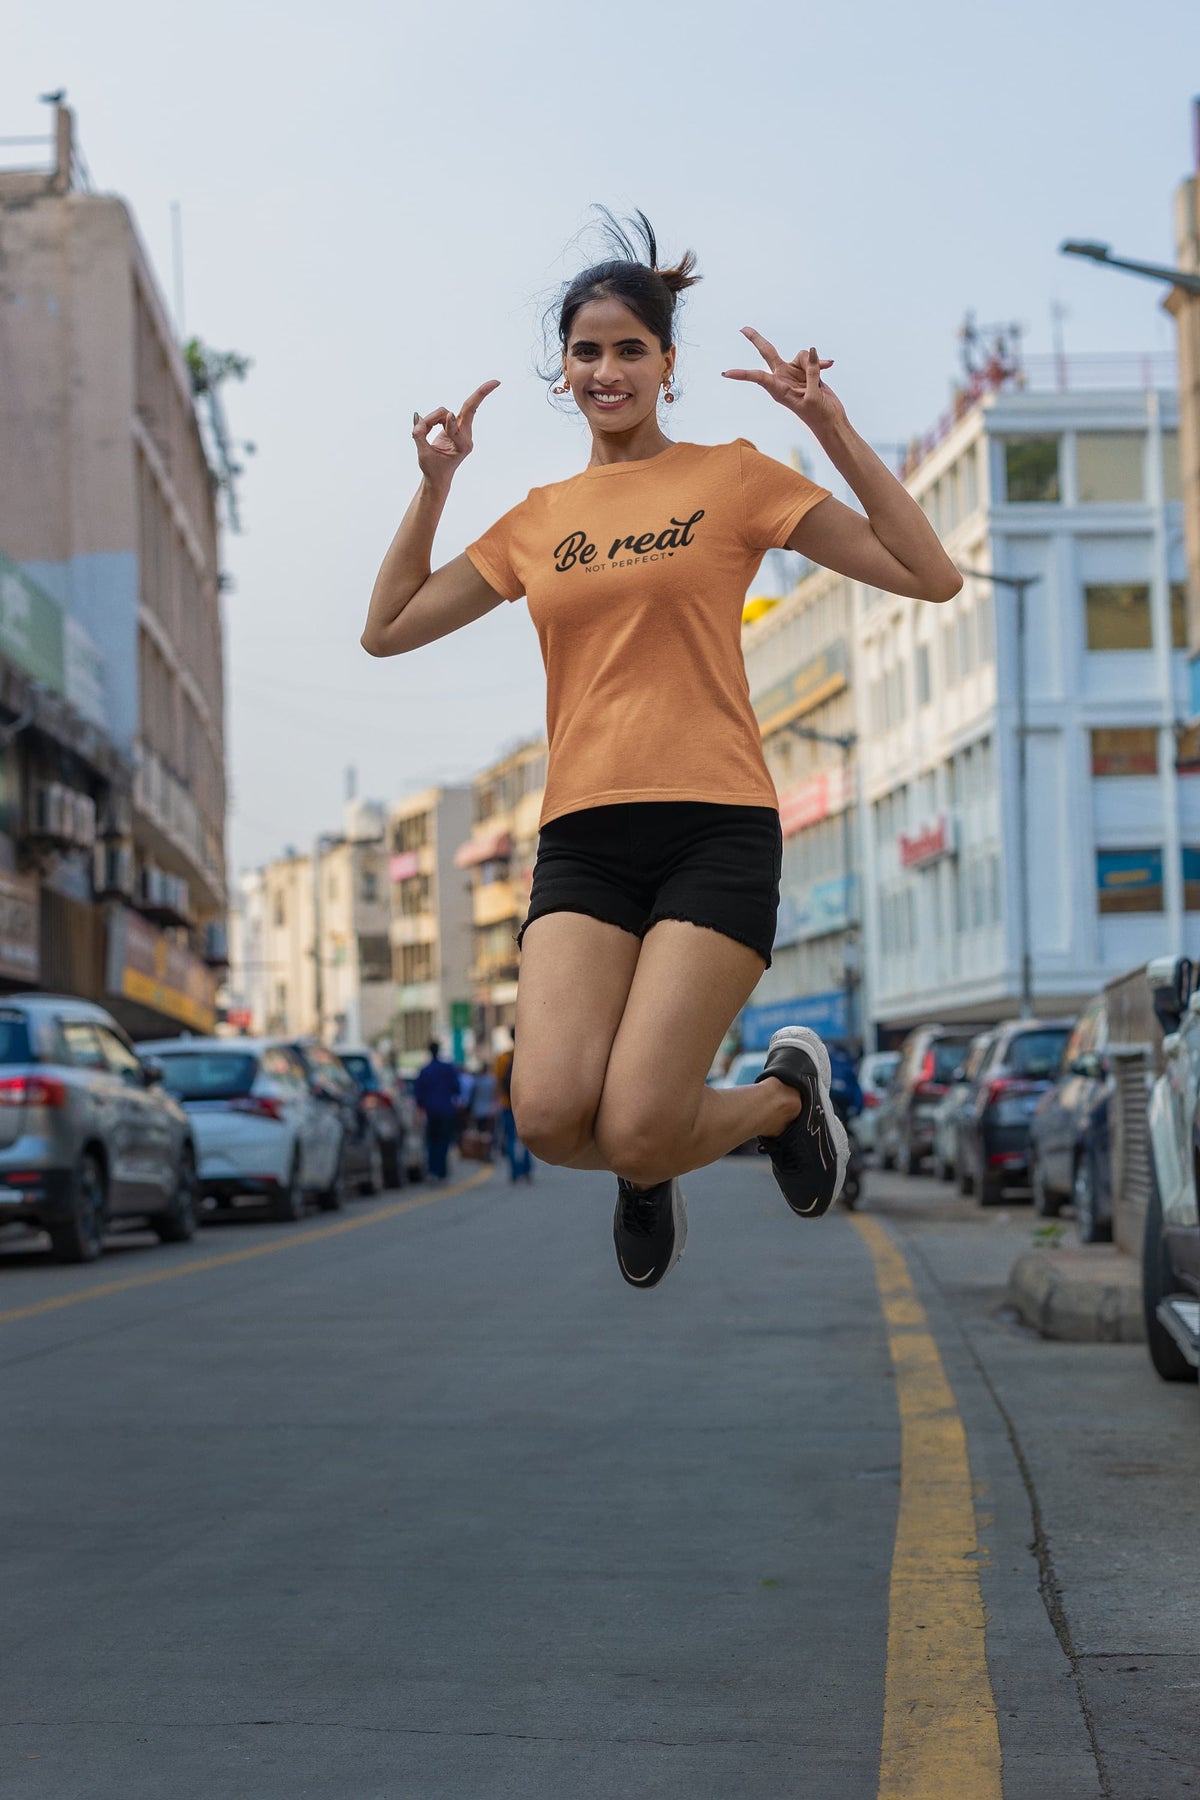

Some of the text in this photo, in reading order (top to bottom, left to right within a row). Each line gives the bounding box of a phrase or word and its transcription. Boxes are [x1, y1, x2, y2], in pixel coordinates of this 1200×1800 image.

[553, 509, 705, 572] Be real
[585, 552, 667, 573] NOT PERFECT
